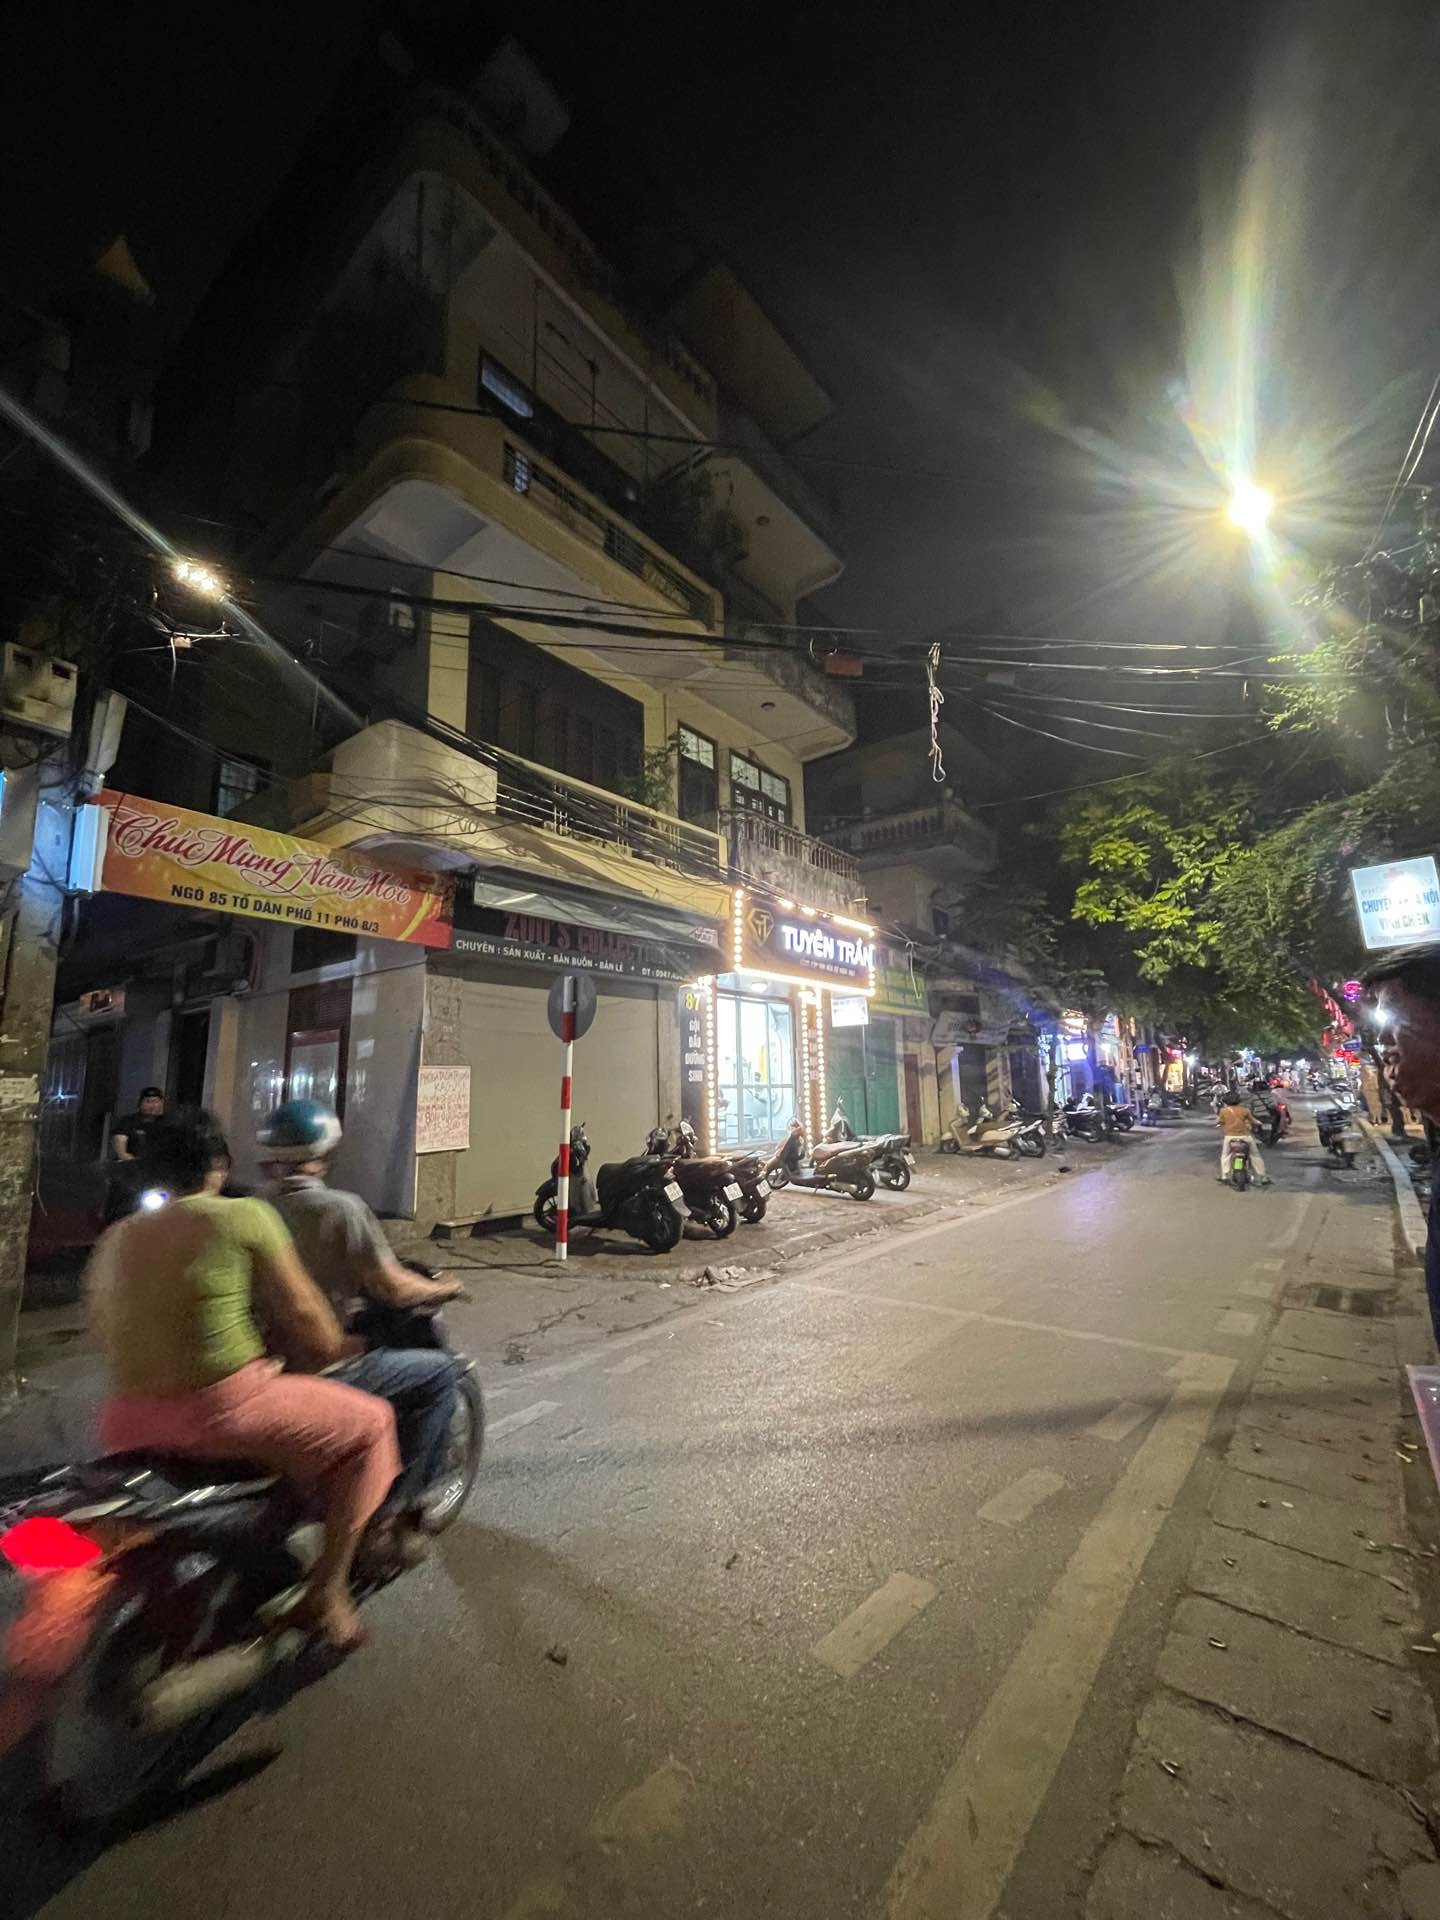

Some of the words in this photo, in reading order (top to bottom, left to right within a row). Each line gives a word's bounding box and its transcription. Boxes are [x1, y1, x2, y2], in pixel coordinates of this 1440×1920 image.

[209, 891, 228, 906] 85
[318, 912, 329, 924] 11
[361, 920, 380, 933] 8/3
[455, 938, 496, 954] CHUYÊN
[781, 925, 834, 960] TUYÊN
[685, 992, 701, 1011] 87
